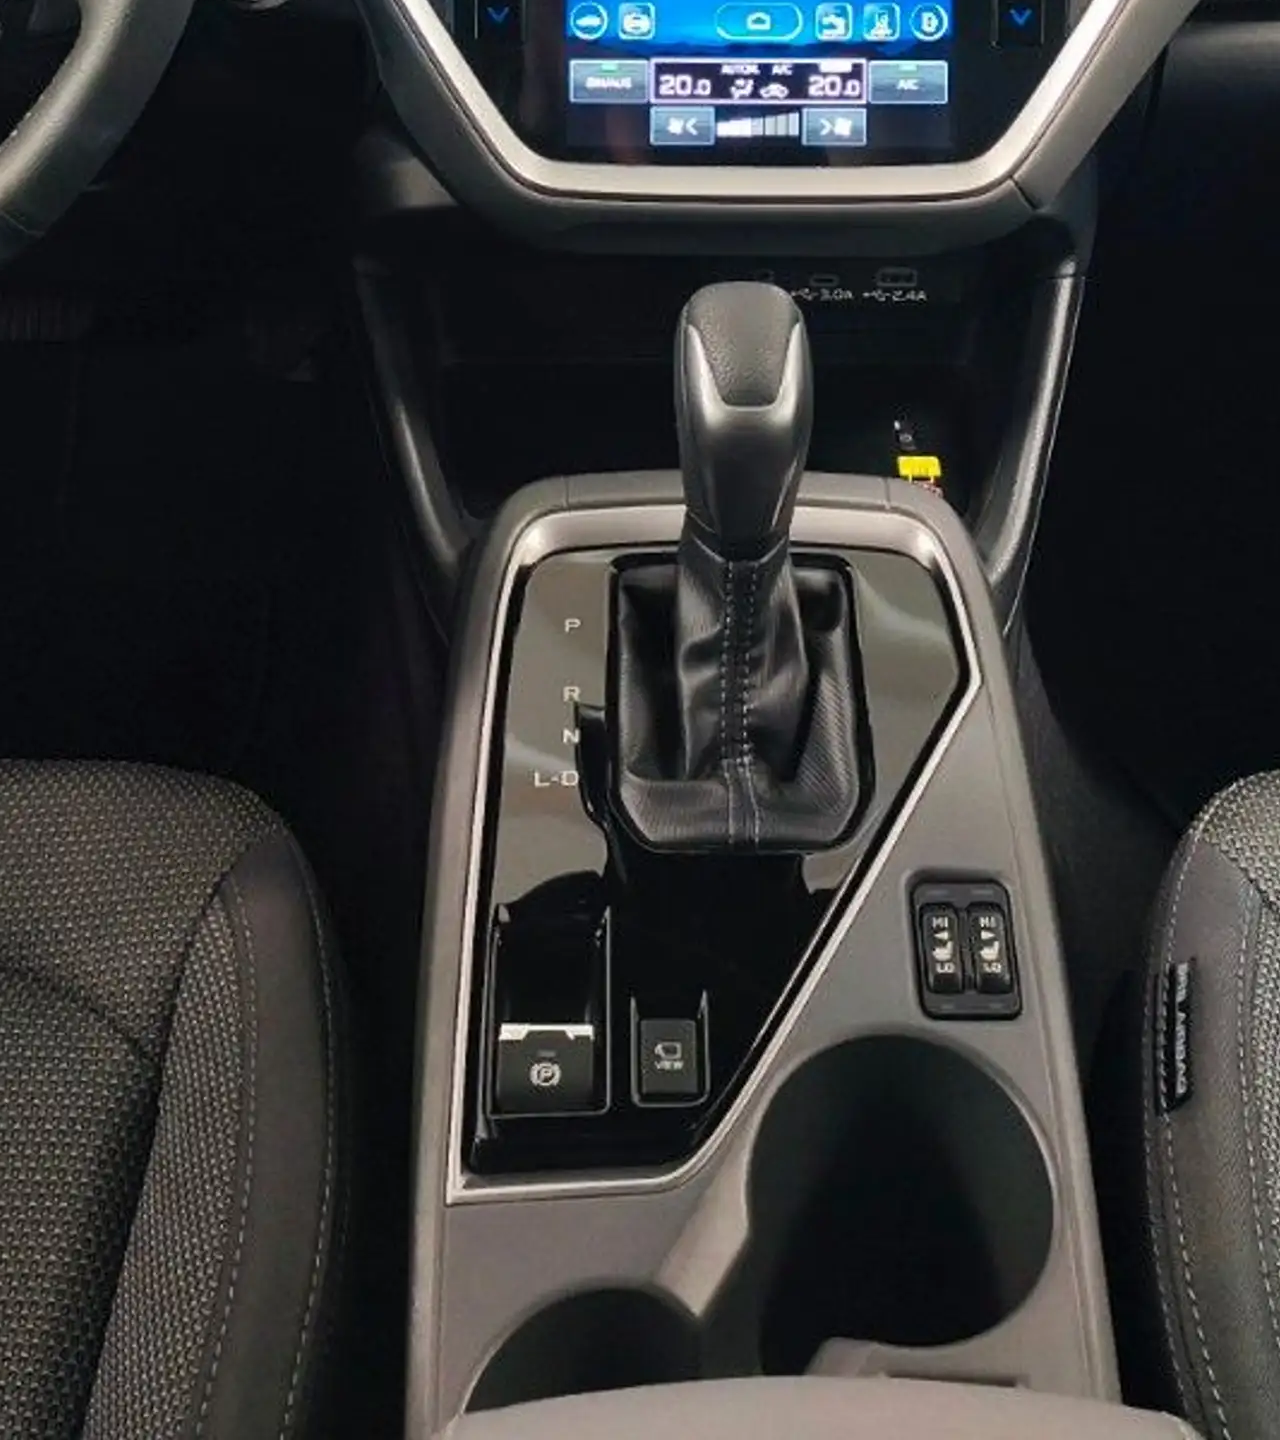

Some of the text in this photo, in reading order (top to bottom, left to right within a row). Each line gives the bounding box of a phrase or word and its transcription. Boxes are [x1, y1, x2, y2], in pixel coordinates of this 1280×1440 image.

[659, 75, 711, 97] 20.0
[808, 75, 861, 97] 20.0
[564, 618, 581, 633] P
[563, 686, 580, 702] R
[563, 729, 580, 744] N
[932, 916, 948, 928] HI
[936, 962, 955, 974] LO
[983, 962, 1001, 974] LO
[654, 1060, 684, 1070] VIEW
